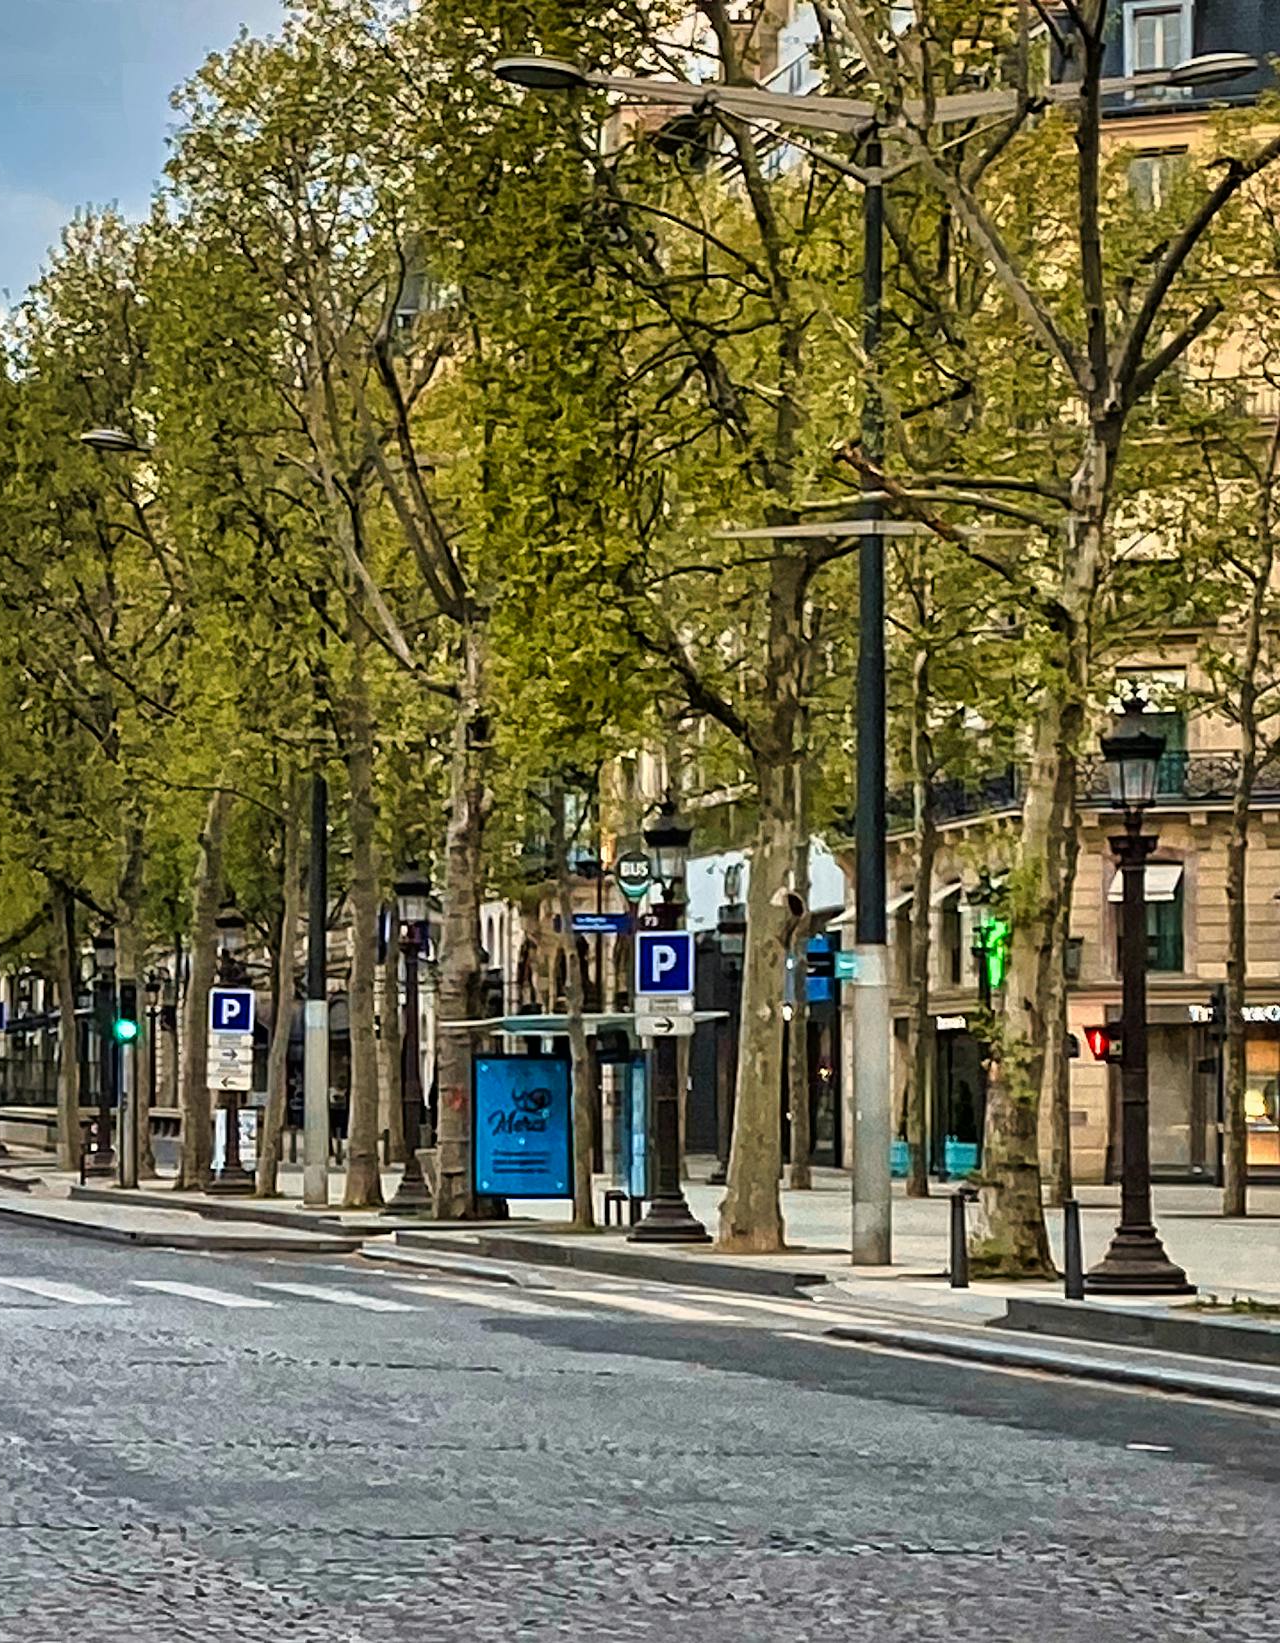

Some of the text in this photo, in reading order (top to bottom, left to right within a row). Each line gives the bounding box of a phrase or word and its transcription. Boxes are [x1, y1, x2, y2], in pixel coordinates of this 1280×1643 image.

[620, 861, 649, 877] BUS
[652, 945, 677, 983] P
[222, 998, 241, 1025] P
